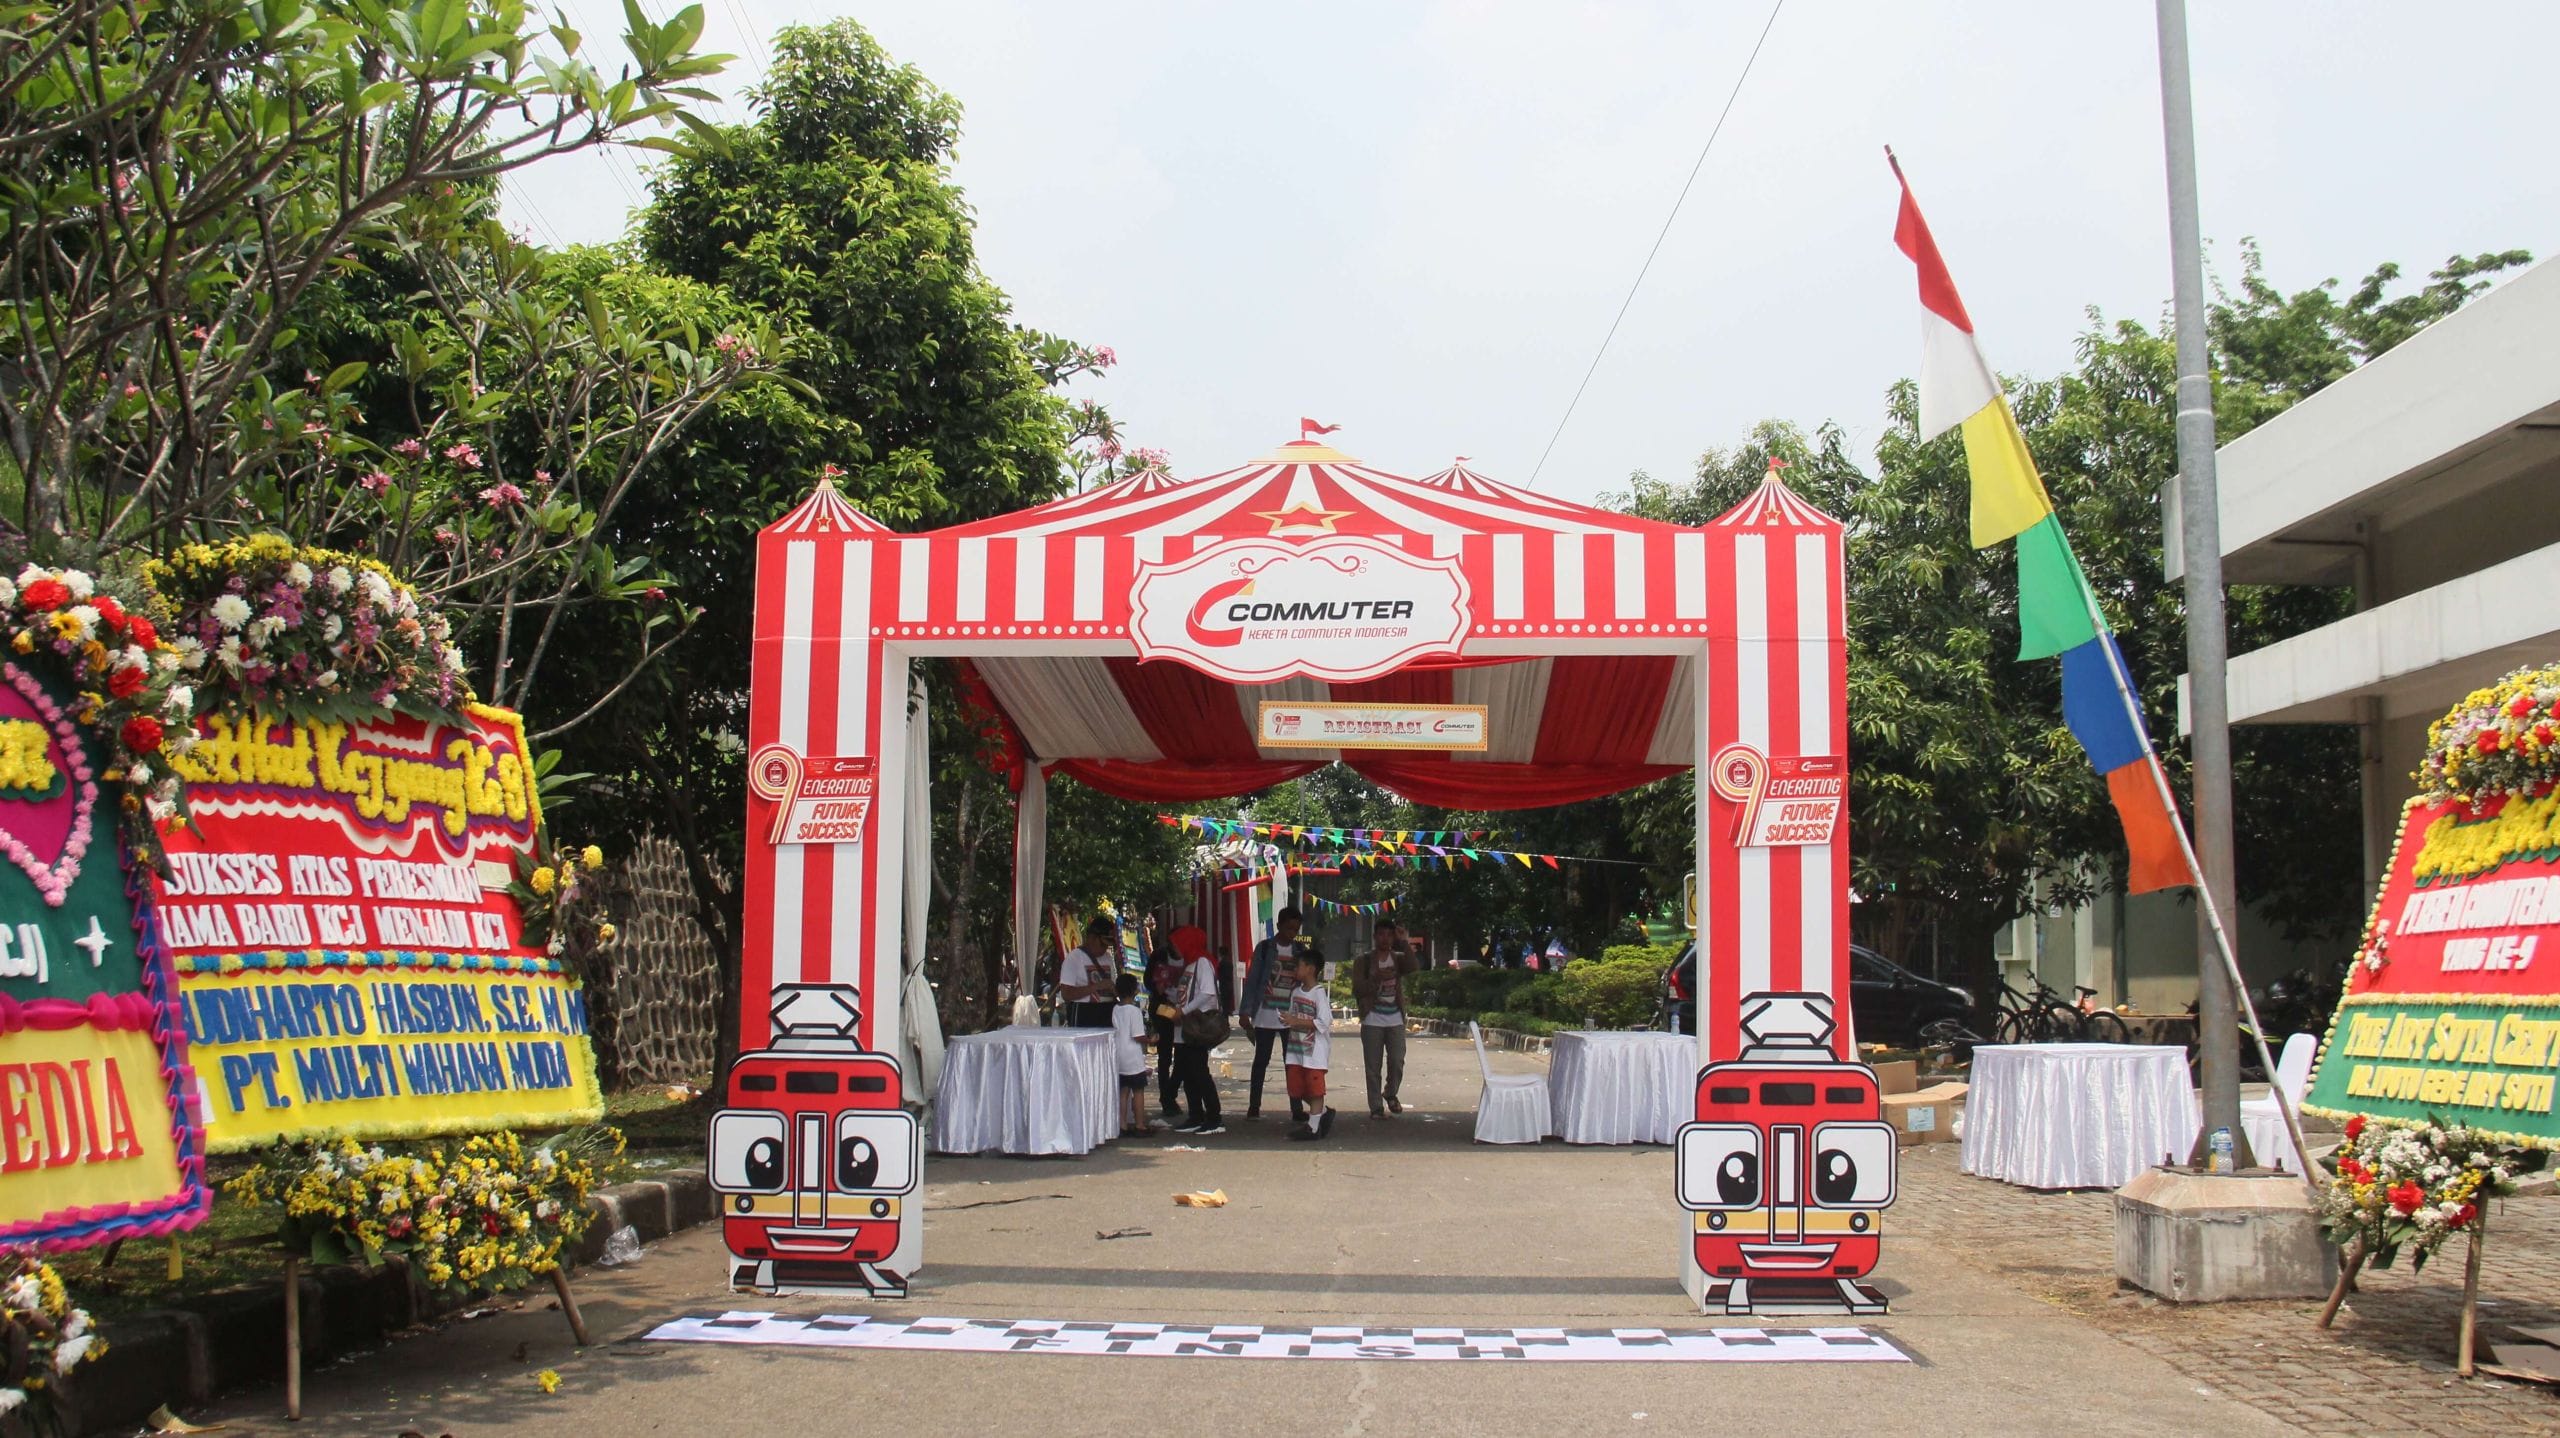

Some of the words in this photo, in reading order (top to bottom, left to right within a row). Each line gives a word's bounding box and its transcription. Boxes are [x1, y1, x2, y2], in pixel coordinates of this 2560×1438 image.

[1228, 600, 1414, 622] COMMUTER
[1249, 628, 1288, 640] KERETA
[1291, 627, 1352, 639] COMMUTER
[1354, 626, 1408, 638] INDONESIA
[1323, 719, 1423, 735] REGISTRASI
[811, 802, 866, 820] FUTURE
[1780, 803, 1836, 822] FUTURE
[797, 821, 859, 840] SUCCESS
[1766, 823, 1829, 842] SUCCESS
[163, 852, 283, 896] SUKSES
[289, 855, 353, 898] ATAS
[356, 857, 485, 904] PERESMIAN
[234, 903, 312, 946] BARU
[312, 905, 367, 946] KCJ
[373, 905, 473, 950] MENJADI
[2427, 1012, 2496, 1063] SUTA
[220, 1051, 291, 1113] PT.
[293, 1043, 400, 1104] MULTI
[399, 1041, 507, 1095] WAHANA
[506, 1040, 573, 1091] MUDA
[0, 1057, 145, 1174] EDIA
